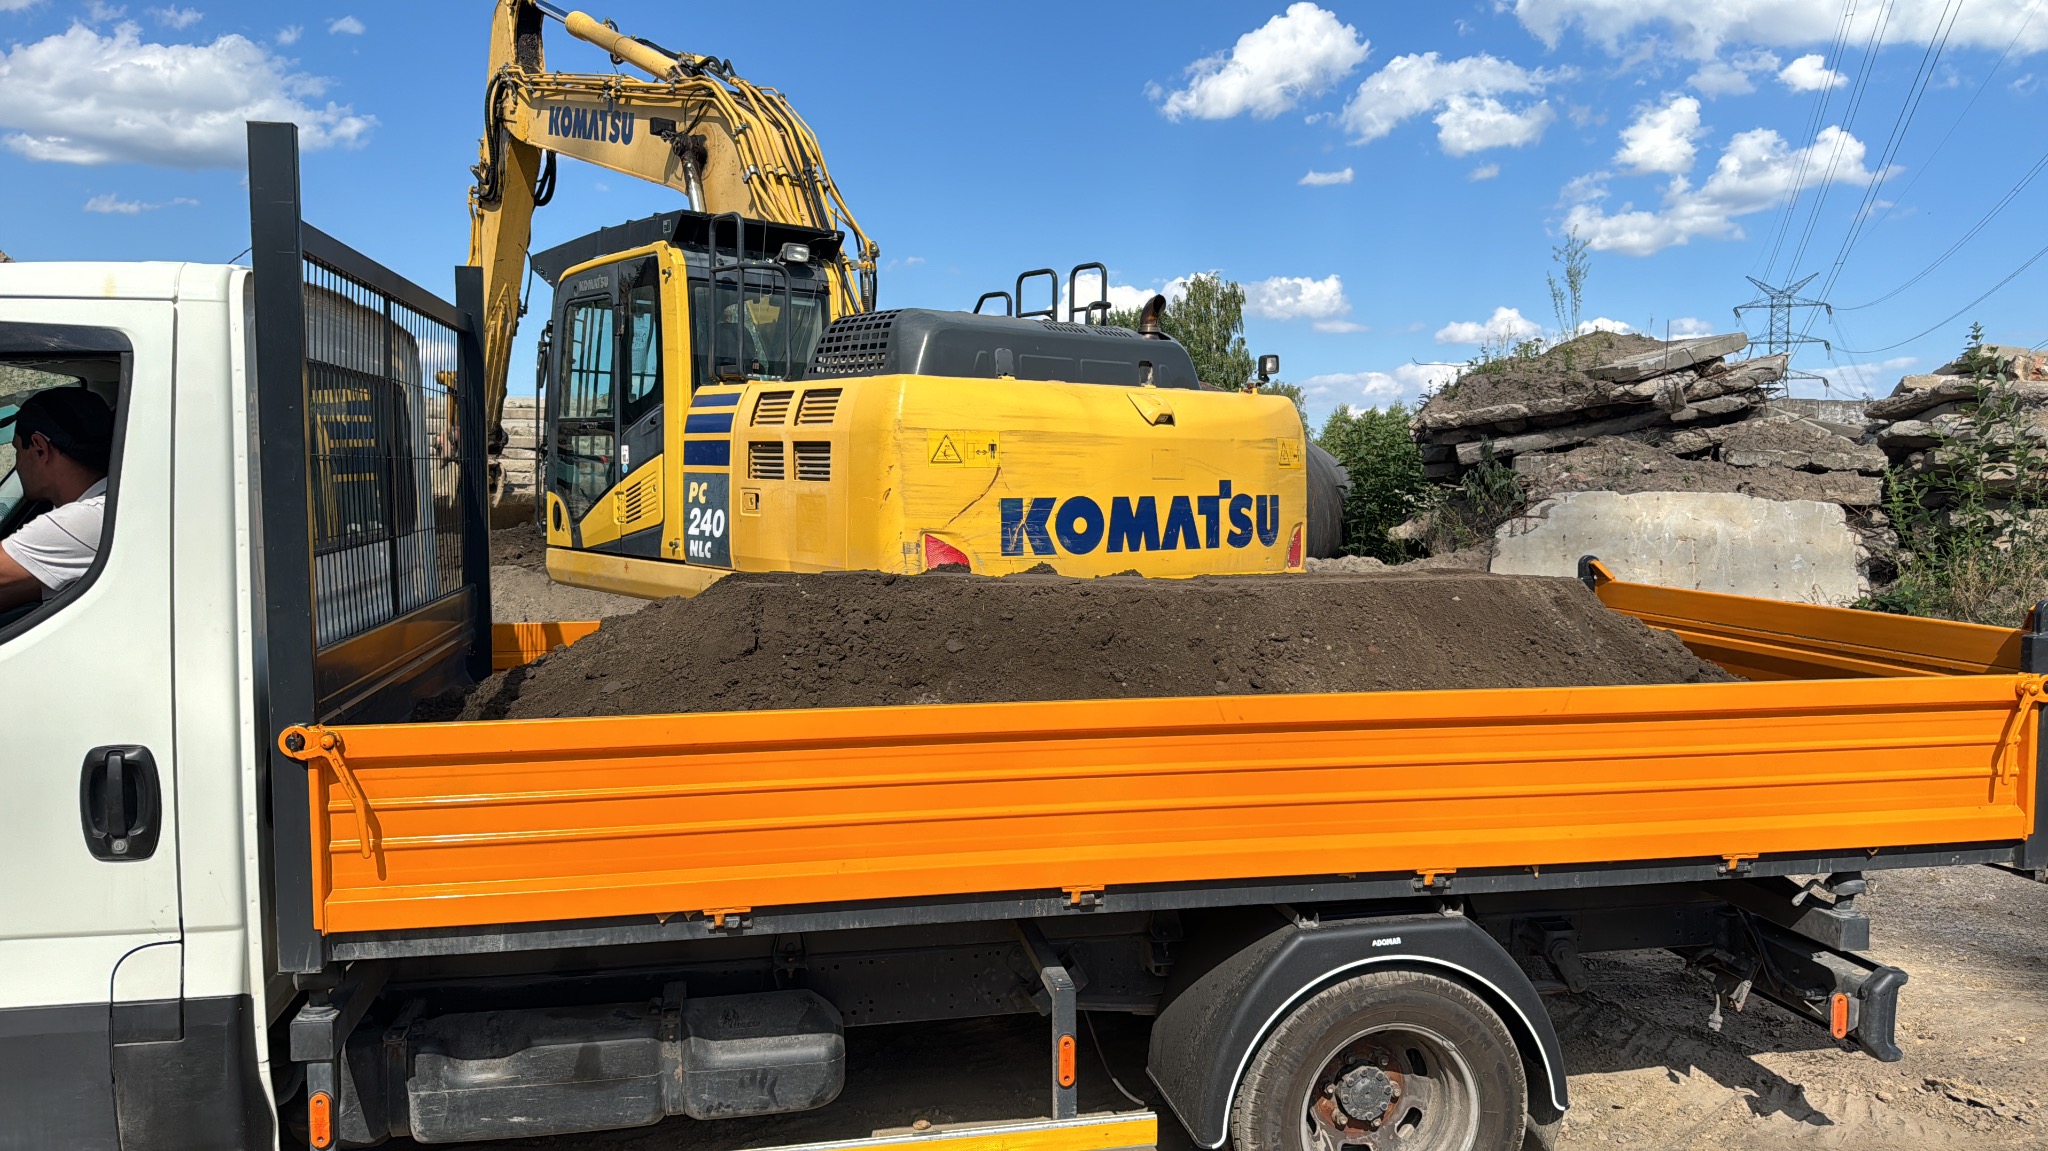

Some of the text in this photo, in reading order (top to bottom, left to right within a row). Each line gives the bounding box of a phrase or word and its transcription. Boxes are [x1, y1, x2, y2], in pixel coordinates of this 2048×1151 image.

[548, 100, 635, 146] KOMATSU
[578, 274, 609, 292] KOMATSU
[687, 481, 708, 504] PC
[687, 507, 726, 538] 240
[1000, 480, 1280, 557] KOMATSU
[688, 539, 712, 559] NLC
